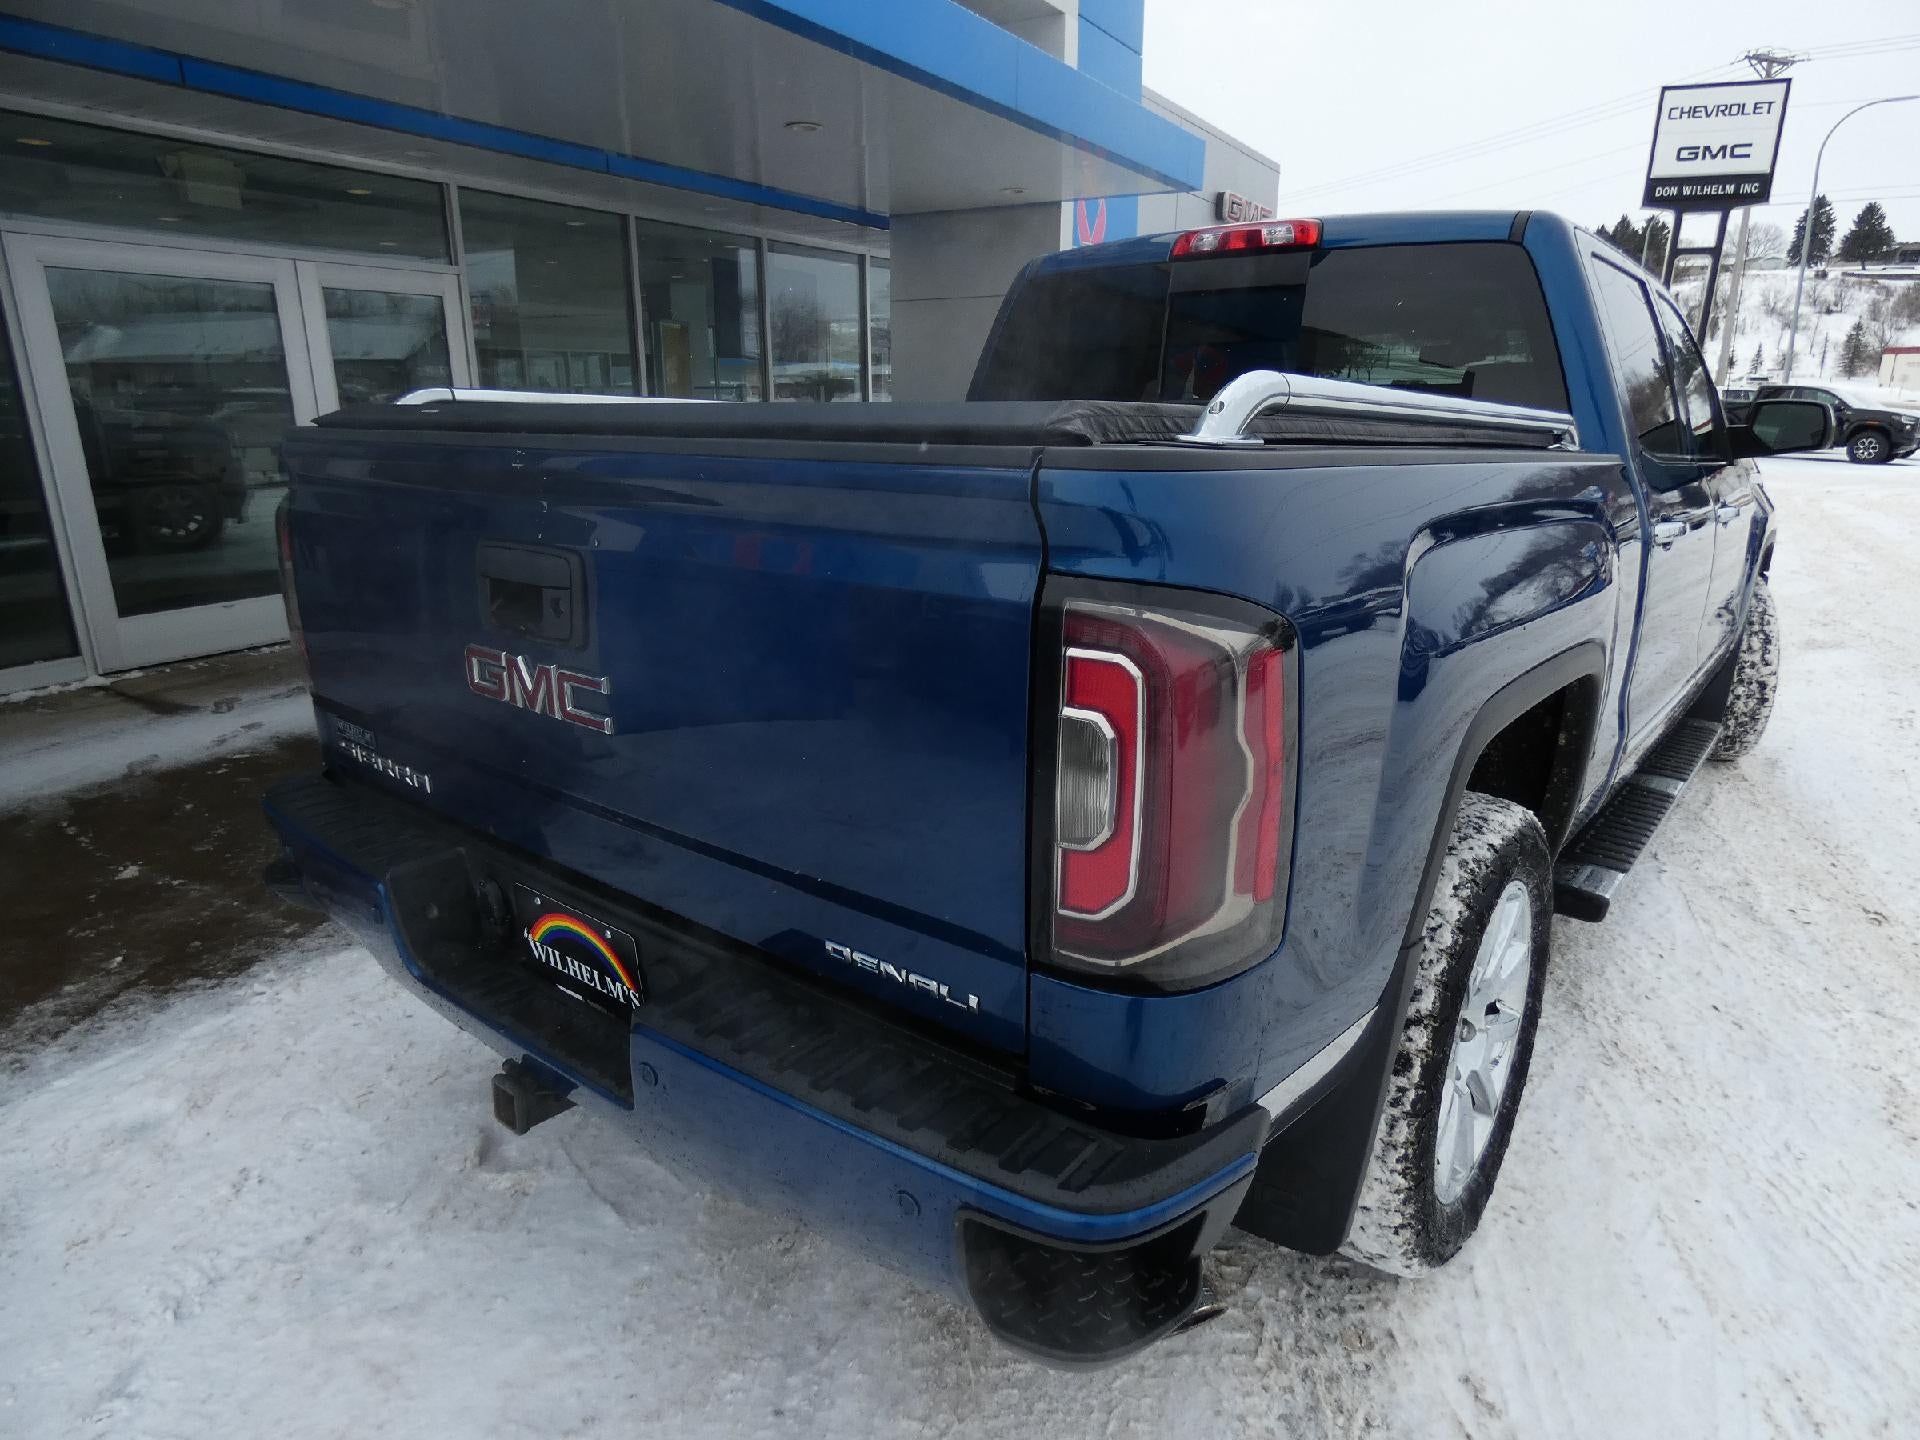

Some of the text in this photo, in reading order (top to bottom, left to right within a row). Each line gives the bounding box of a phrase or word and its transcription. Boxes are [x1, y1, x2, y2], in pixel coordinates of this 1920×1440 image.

[1667, 101, 1776, 120] CHEVROLET
[1676, 143, 1753, 162] GMC
[1655, 182, 1760, 198] DON WILHELM INC
[464, 643, 613, 735] GMC
[524, 927, 641, 1010] WILHELM'S
[824, 938, 979, 1016] DENALI
